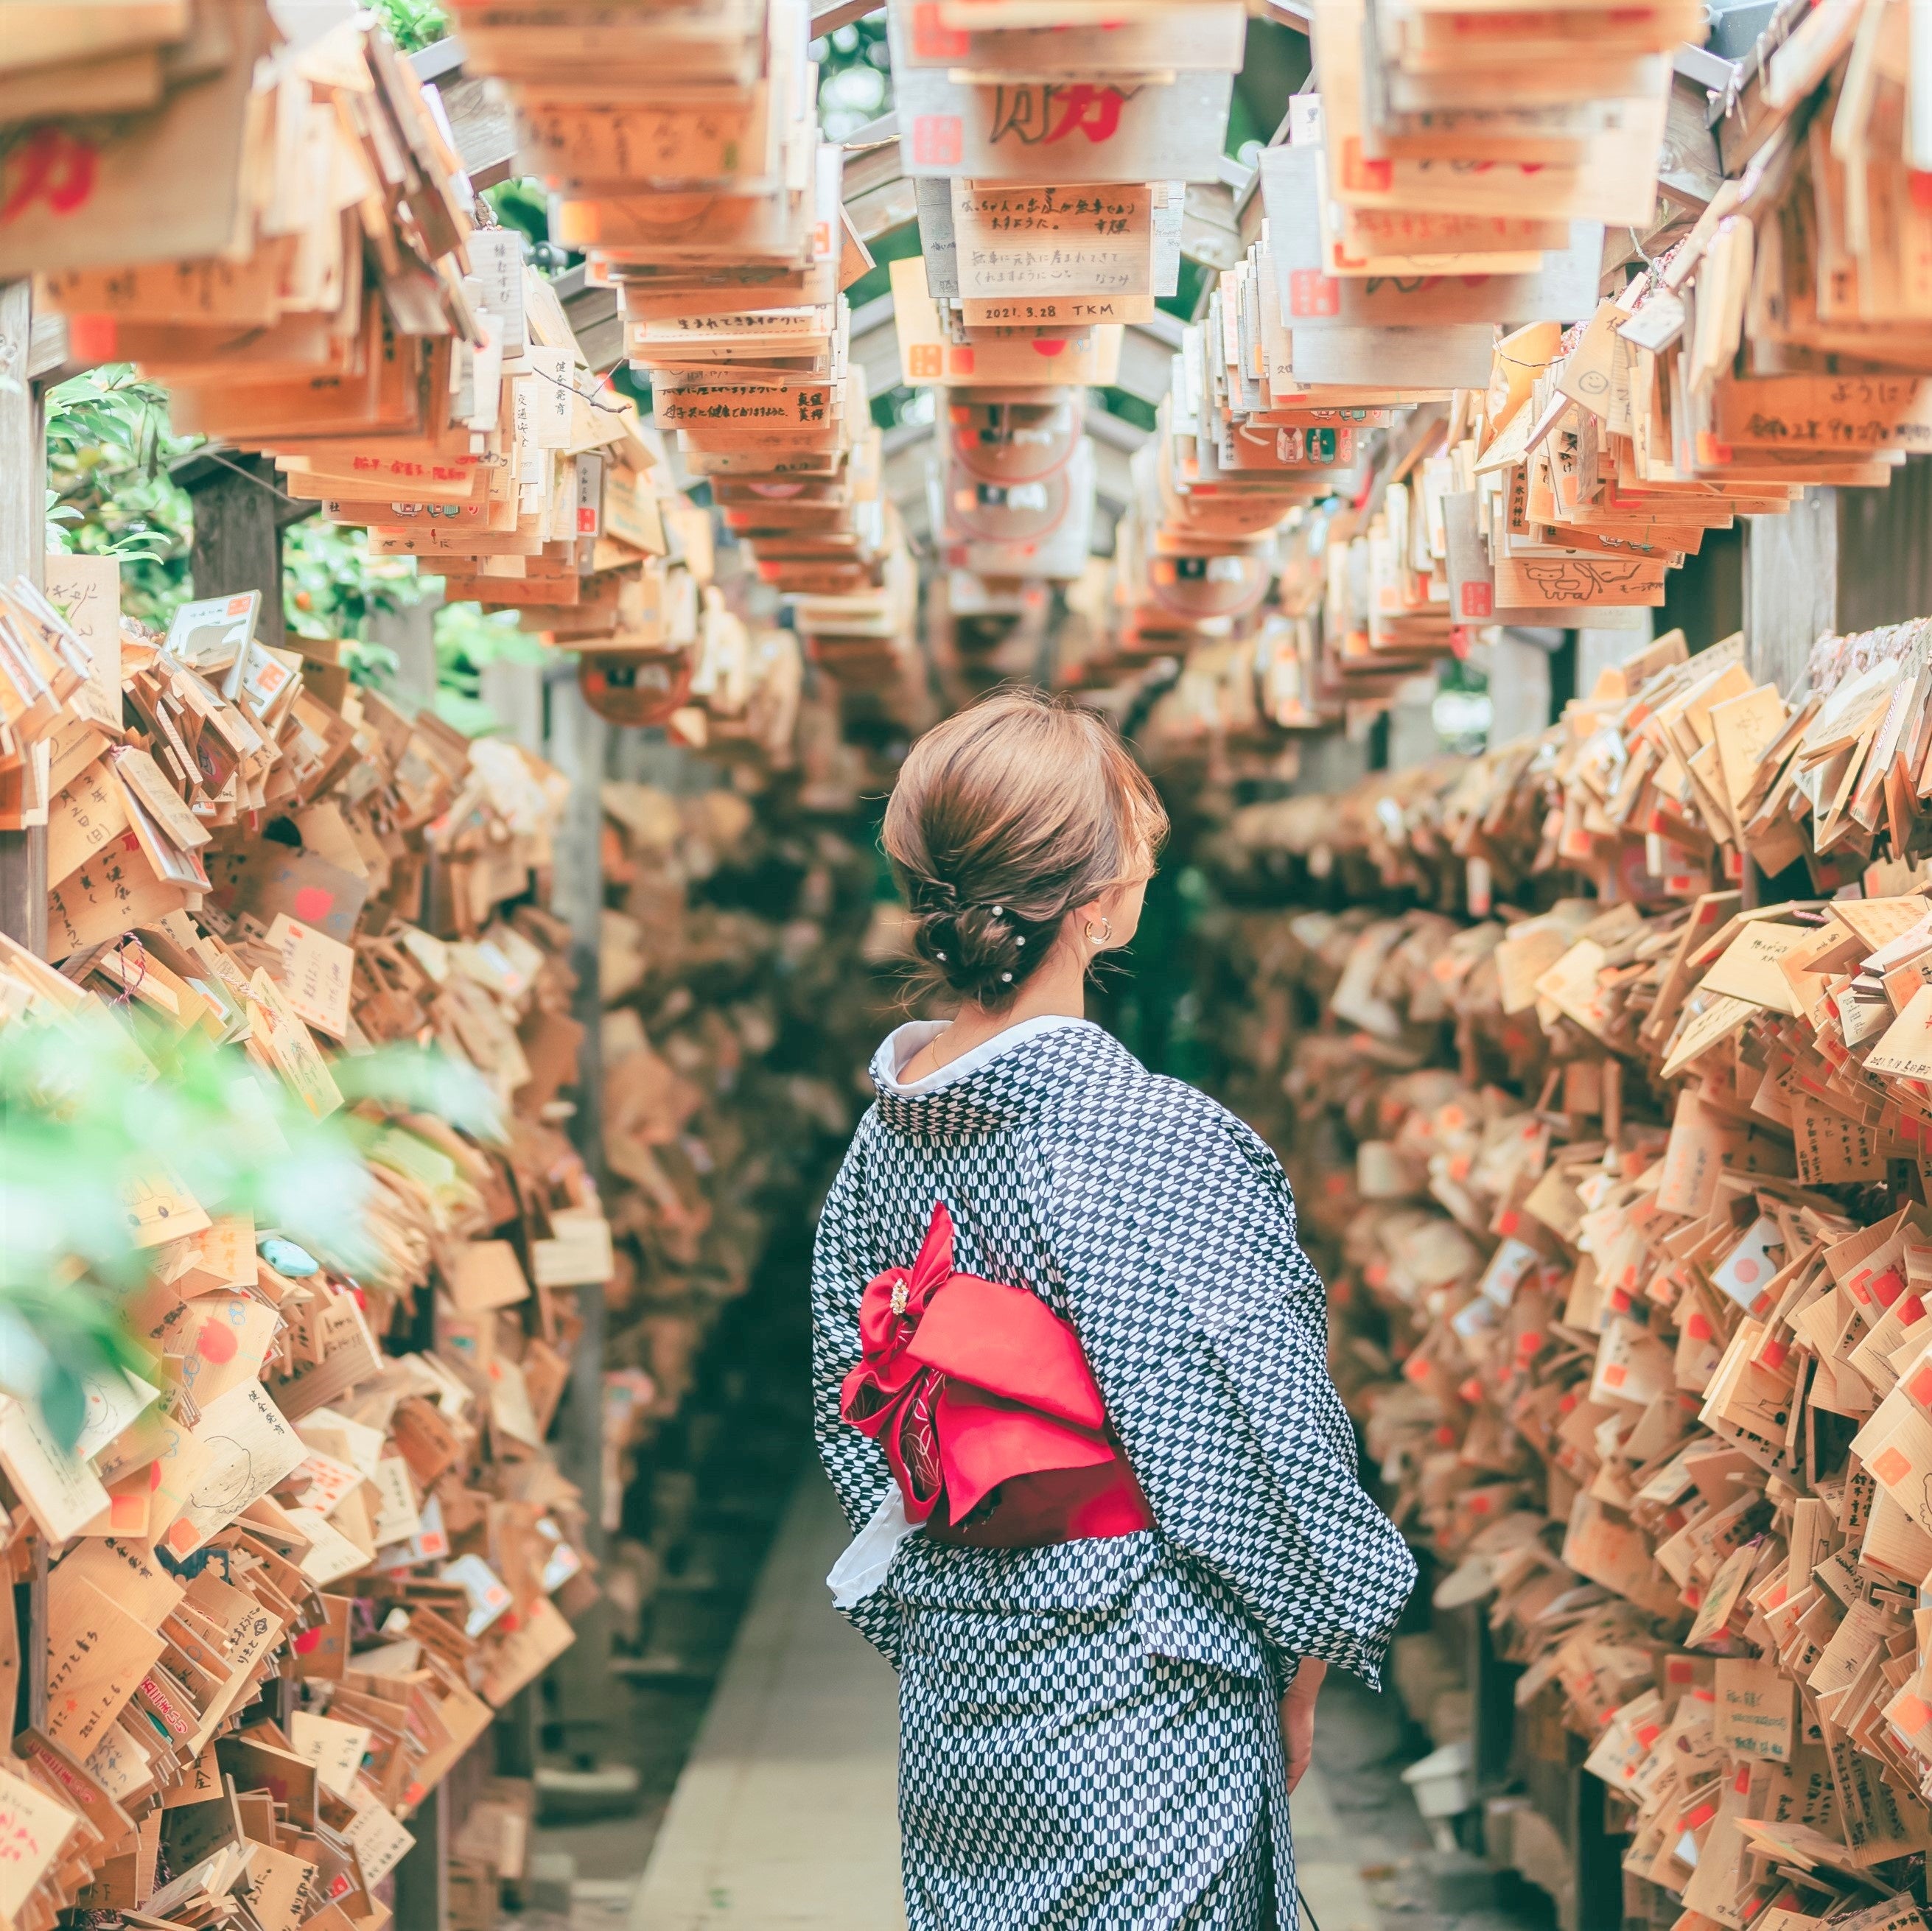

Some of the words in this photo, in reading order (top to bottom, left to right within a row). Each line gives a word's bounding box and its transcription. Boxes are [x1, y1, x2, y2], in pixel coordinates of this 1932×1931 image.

[985, 305, 1057, 318] 2021.3.28
[1072, 304, 1114, 315] TKM
[517, 393, 530, 447] 交通安全
[248, 1390, 284, 1435] 健全発育
